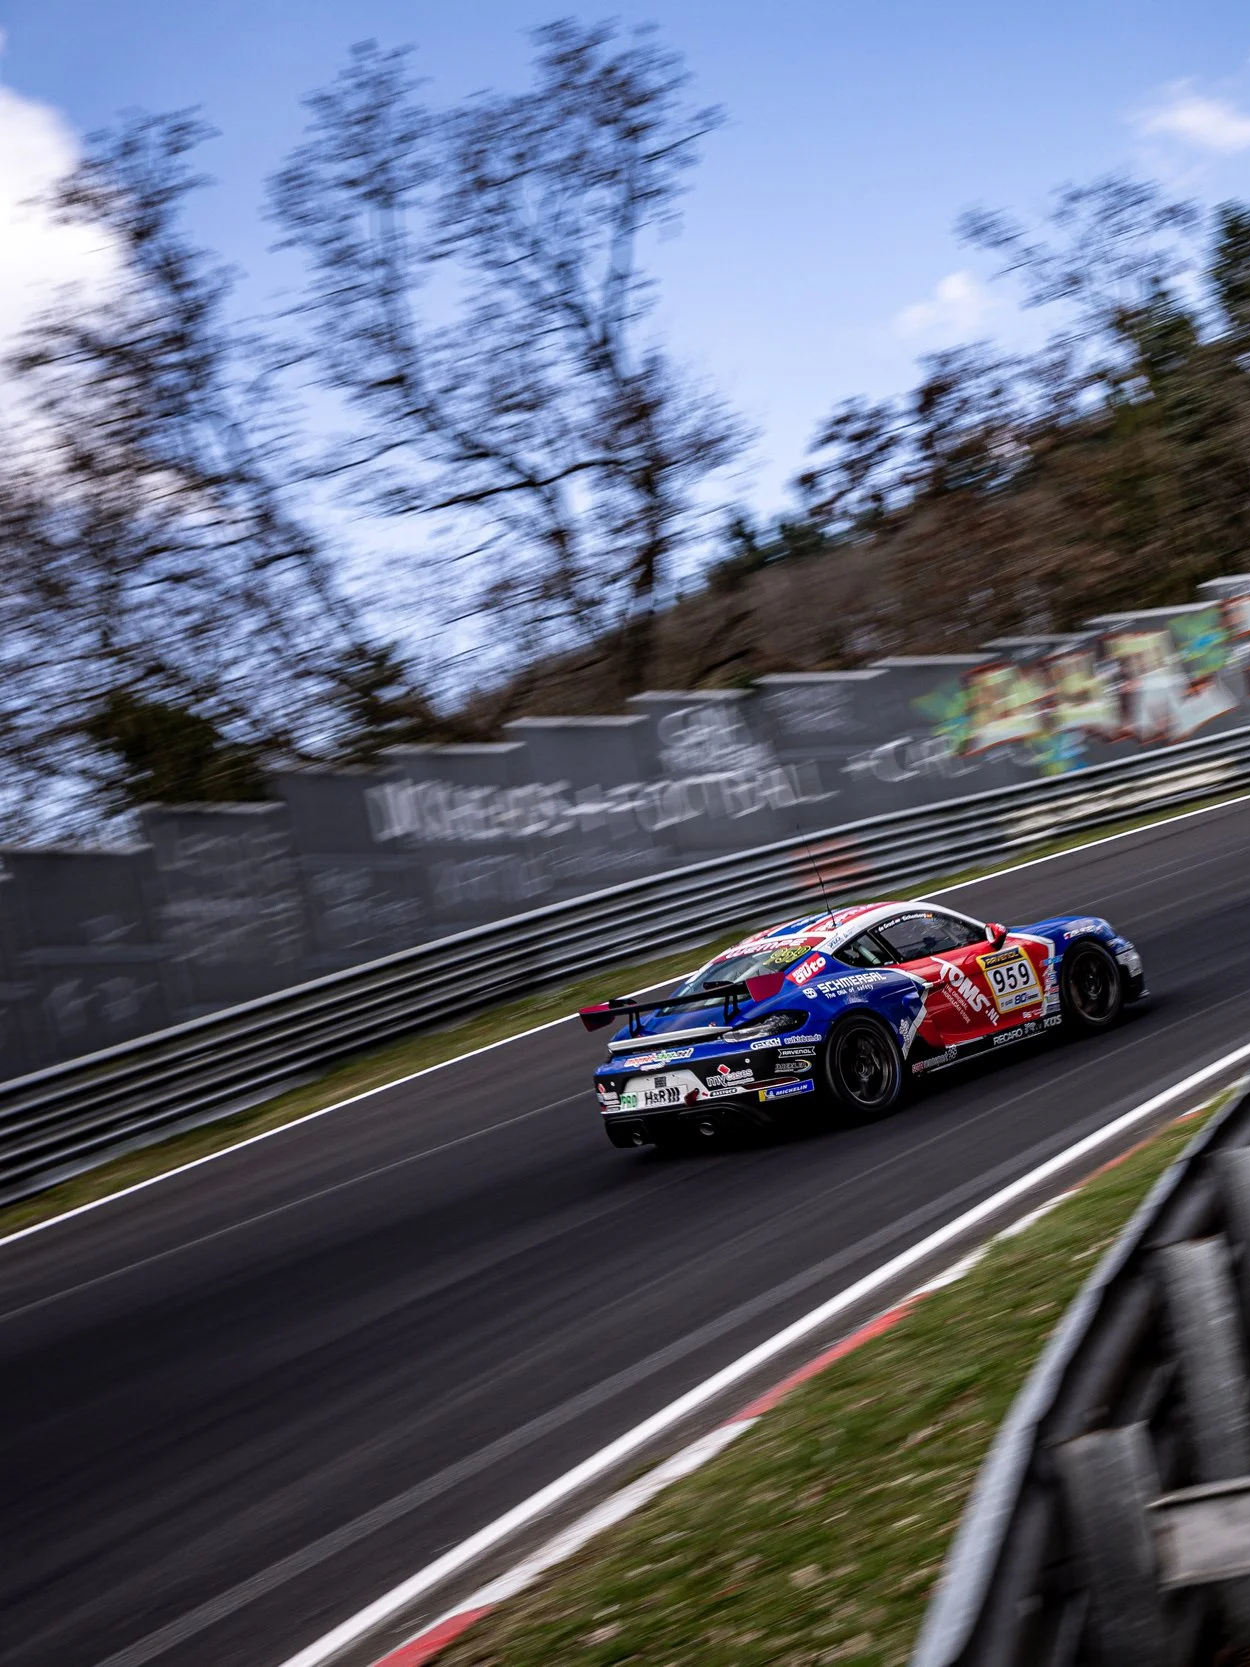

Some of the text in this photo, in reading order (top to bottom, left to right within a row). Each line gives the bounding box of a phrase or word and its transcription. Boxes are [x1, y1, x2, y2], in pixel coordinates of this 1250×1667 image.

[817, 971, 887, 993] SCHMERSAL
[993, 962, 1030, 993] 959
[857, 983, 874, 992] safety
[993, 1028, 1023, 1046] RECARO
[775, 1084, 808, 1096] MICHELIN
